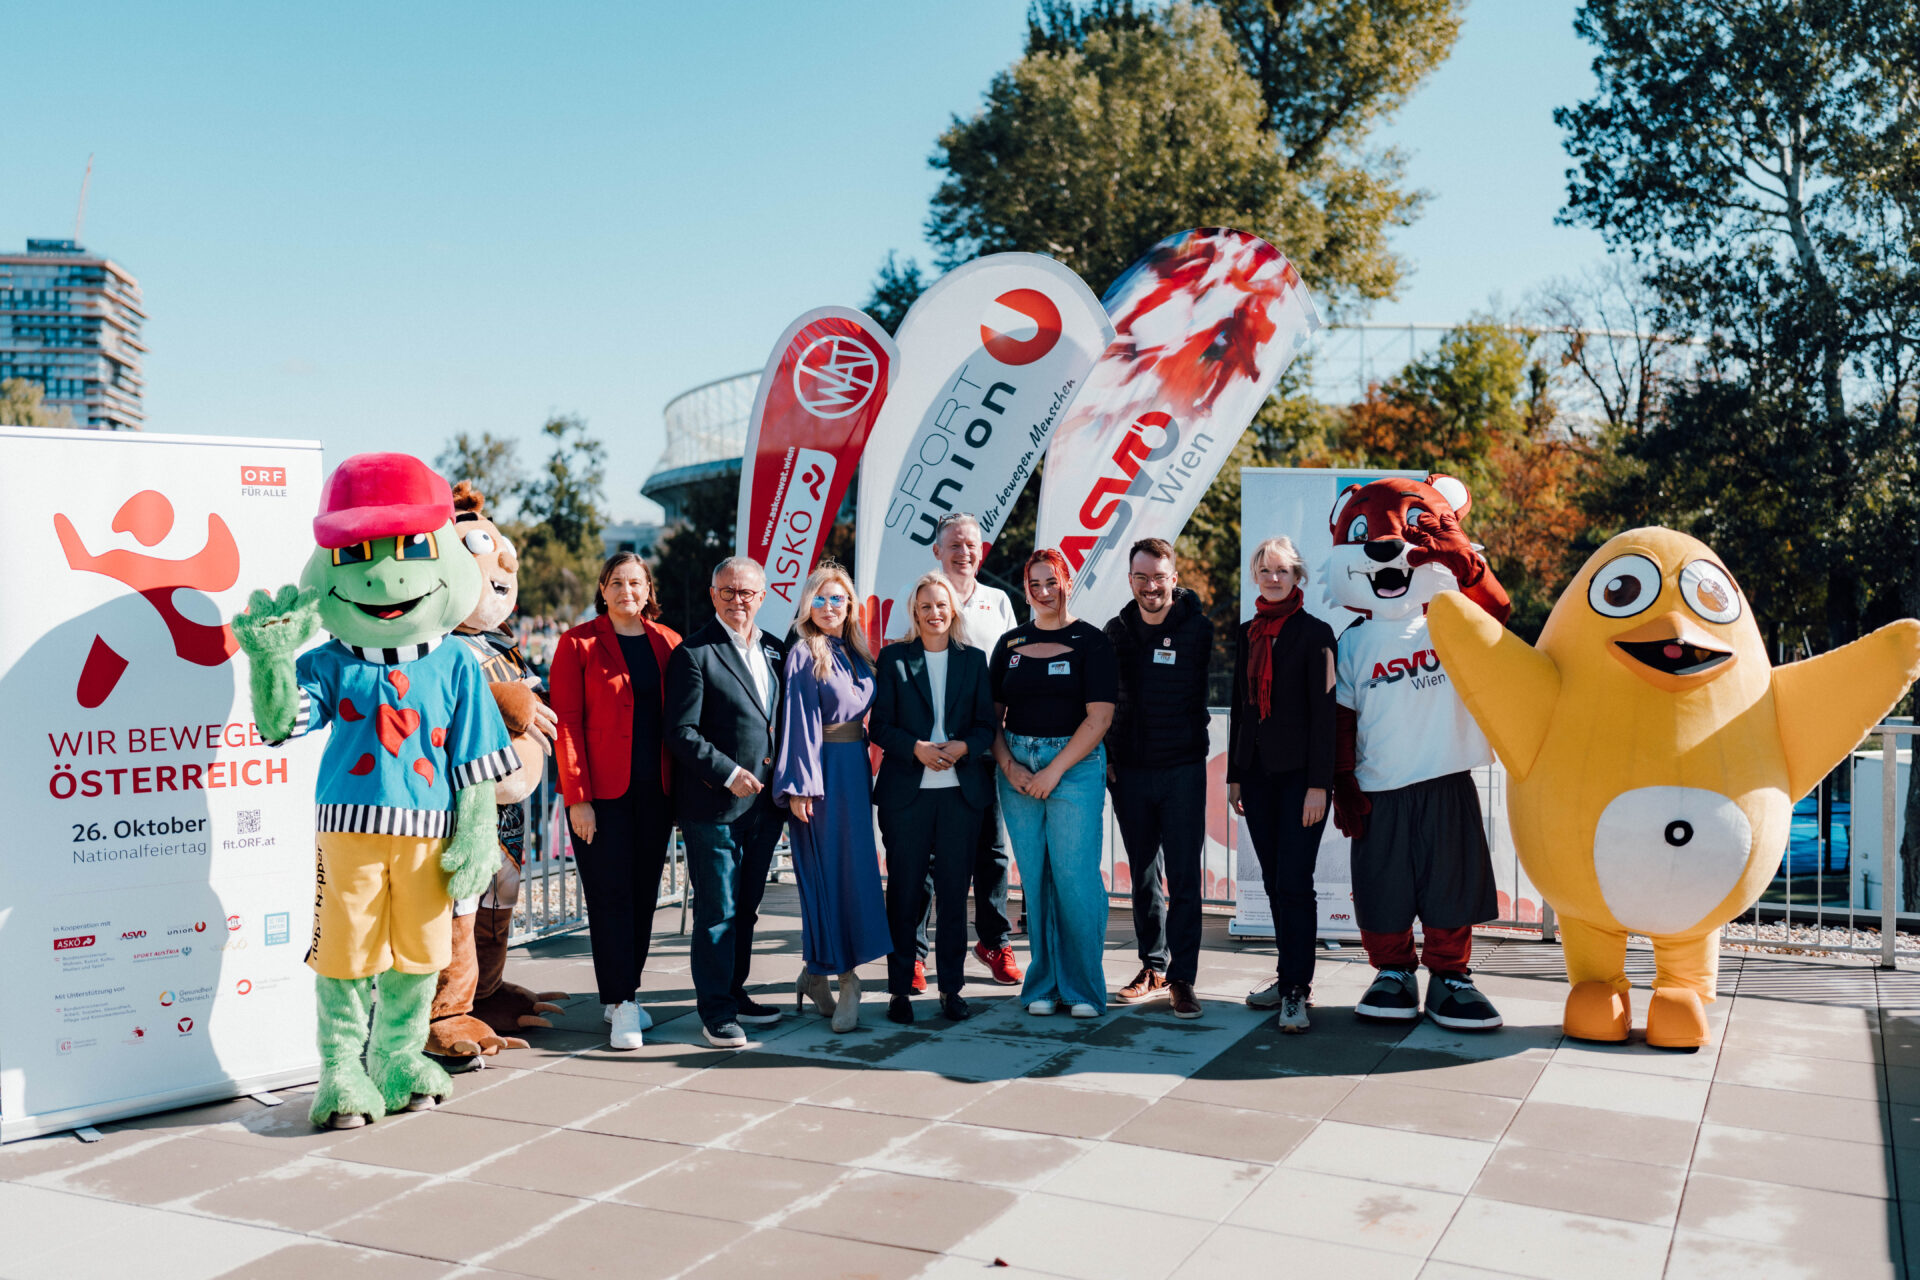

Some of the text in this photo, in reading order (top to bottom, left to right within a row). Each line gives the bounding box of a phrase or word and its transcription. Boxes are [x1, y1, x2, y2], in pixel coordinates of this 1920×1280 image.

[885, 365, 981, 536] SPORT
[979, 379, 1076, 534] Wir bewegen Menschen
[1150, 432, 1215, 505] Wien
[241, 486, 287, 497] FÜR ALLE
[244, 469, 283, 483] ORF
[761, 446, 796, 547] www.askoewat.wien
[770, 510, 813, 603] ASKÖ
[1411, 673, 1446, 690] Wien
[48, 722, 263, 758] WIR BEWEGE
[48, 757, 288, 800] ÖSTERREICH
[72, 816, 207, 843] 26. Oktober
[223, 836, 276, 850] fit.ORF.at
[72, 841, 207, 864] Nationalfeiertag
